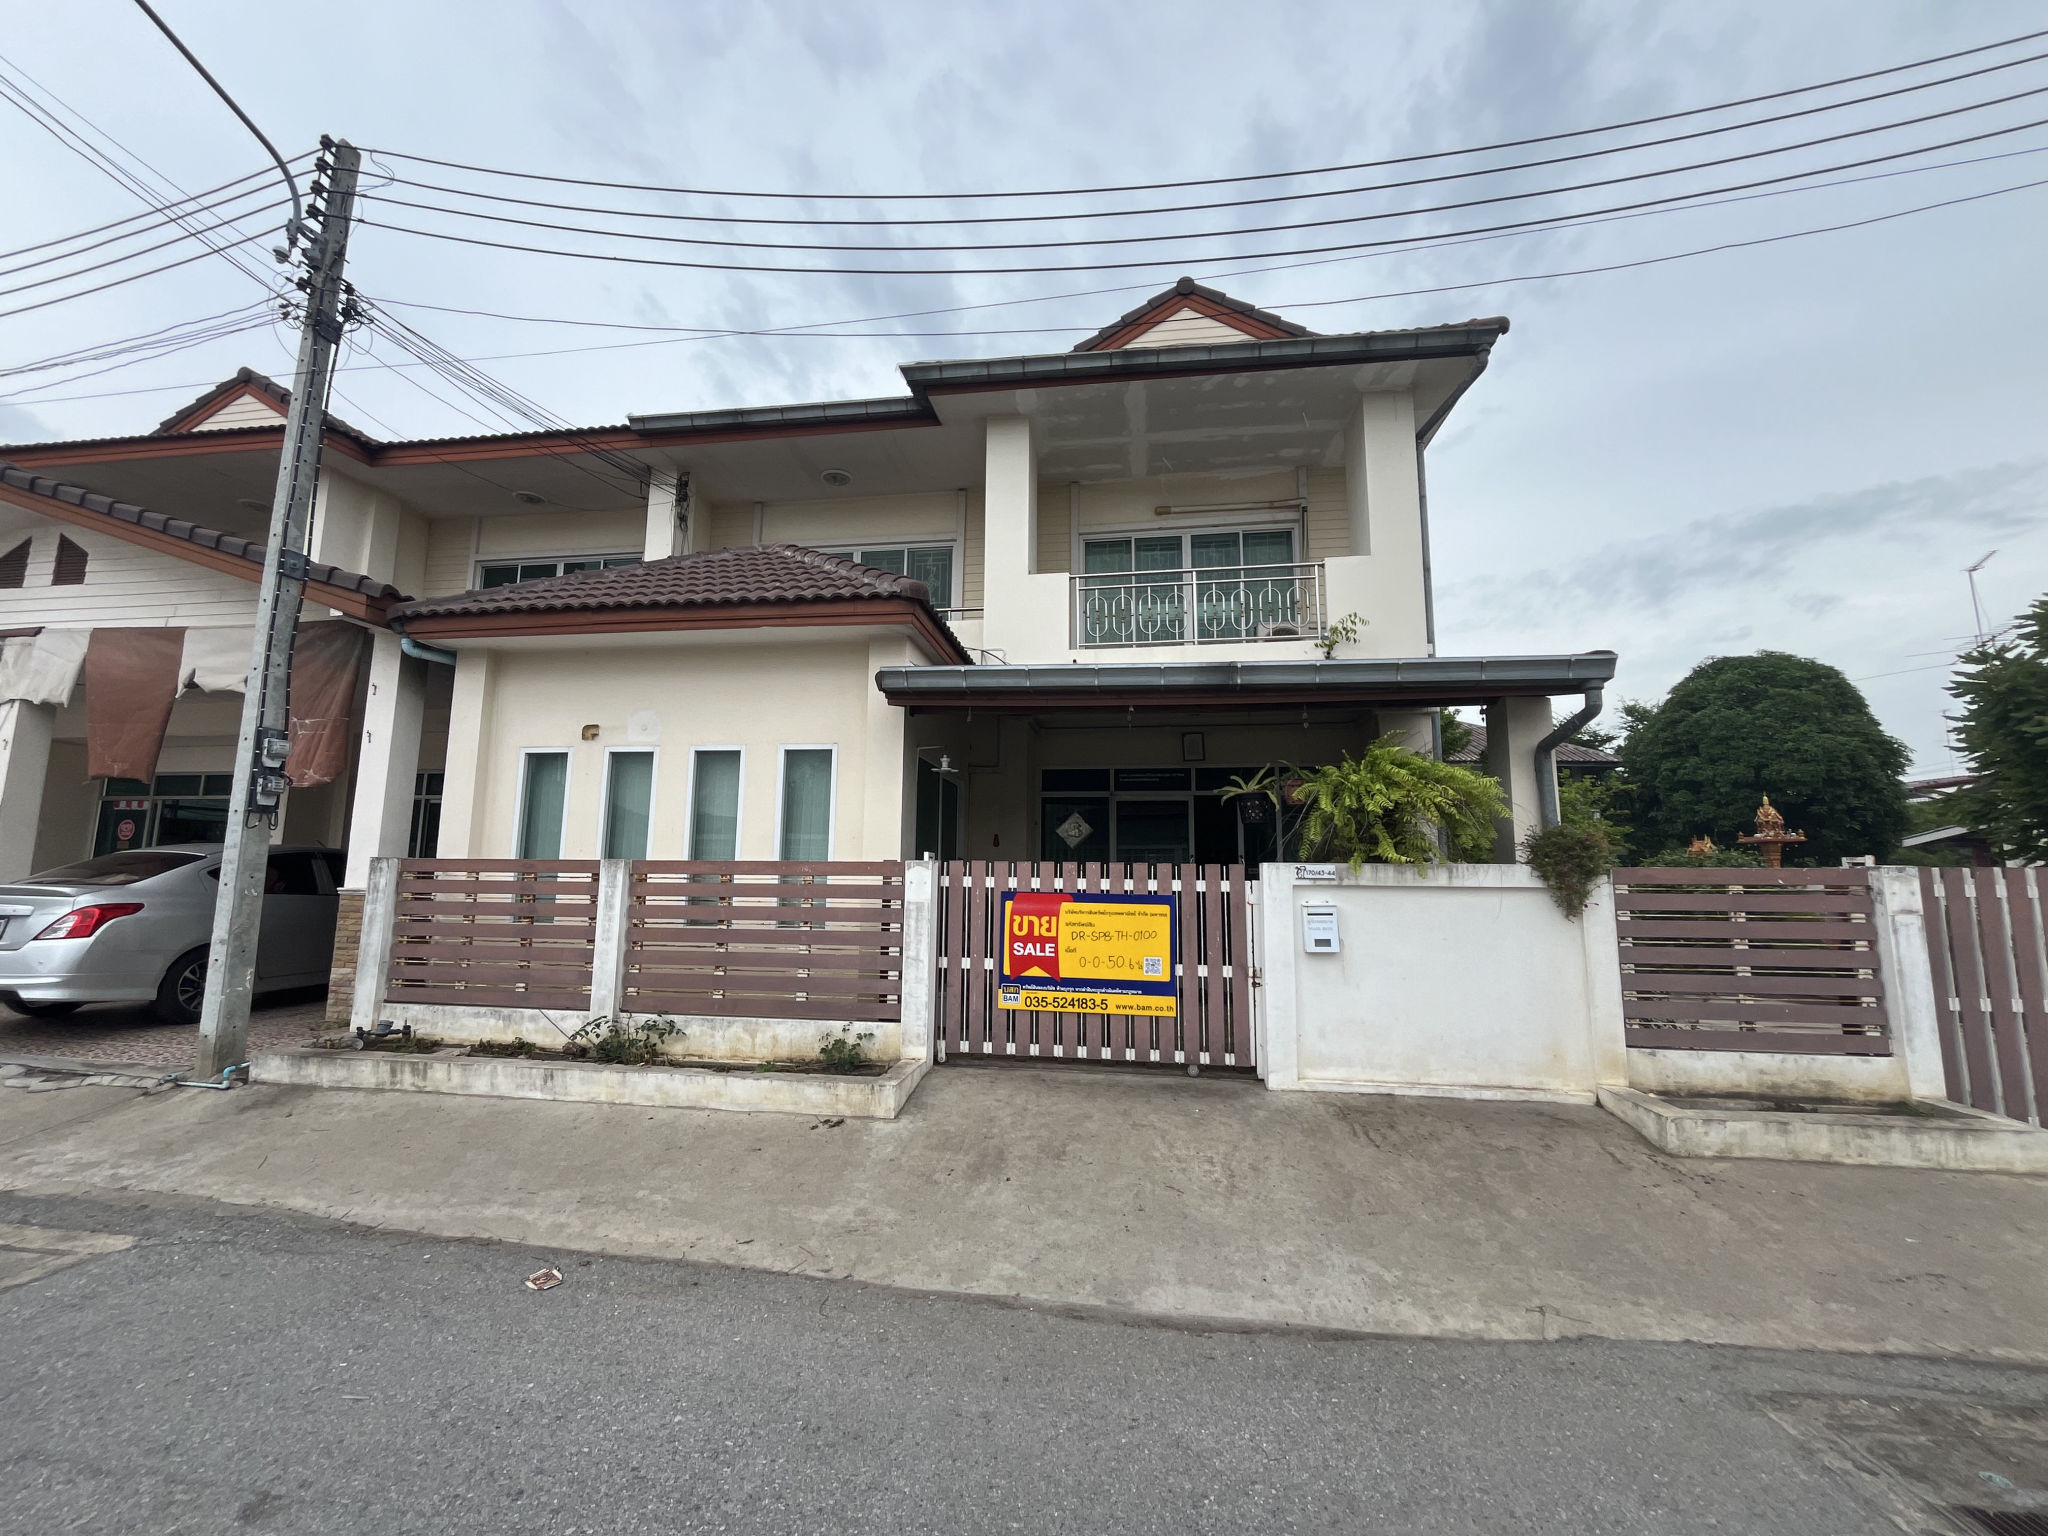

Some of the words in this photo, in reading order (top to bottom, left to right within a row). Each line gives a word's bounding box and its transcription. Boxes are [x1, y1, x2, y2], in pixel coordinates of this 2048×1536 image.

[1013, 915, 1057, 937] ขาย
[1013, 941, 1056, 957] SALE
[1003, 994, 1019, 1002] BAM
[1025, 996, 1108, 1010] 035-524183-5
[1115, 1003, 1174, 1012] www.bam.co.th
